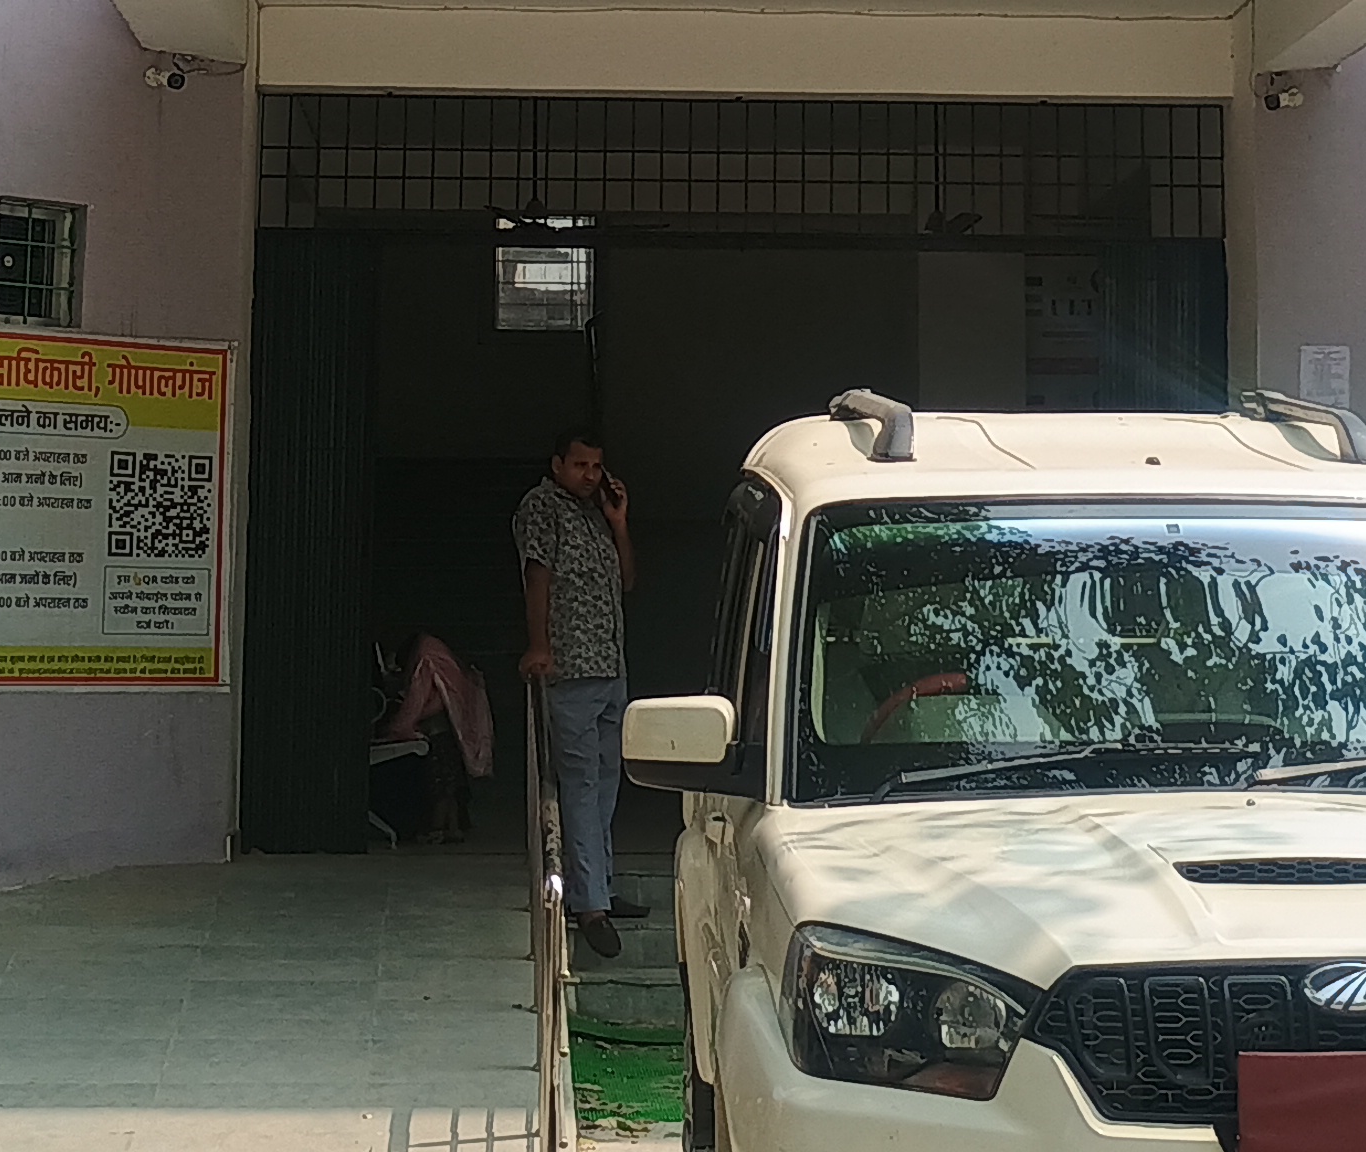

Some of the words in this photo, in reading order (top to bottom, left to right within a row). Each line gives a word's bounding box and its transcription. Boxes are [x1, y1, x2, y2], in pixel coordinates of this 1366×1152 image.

[107, 355, 216, 400] गोपालगंज
[36, 410, 59, 430] का
[62, 412, 121, 433] समय:-
[1, 472, 22, 484] आम
[48, 471, 58, 485] के
[41, 571, 51, 585] के
[143, 575, 157, 585] QR
